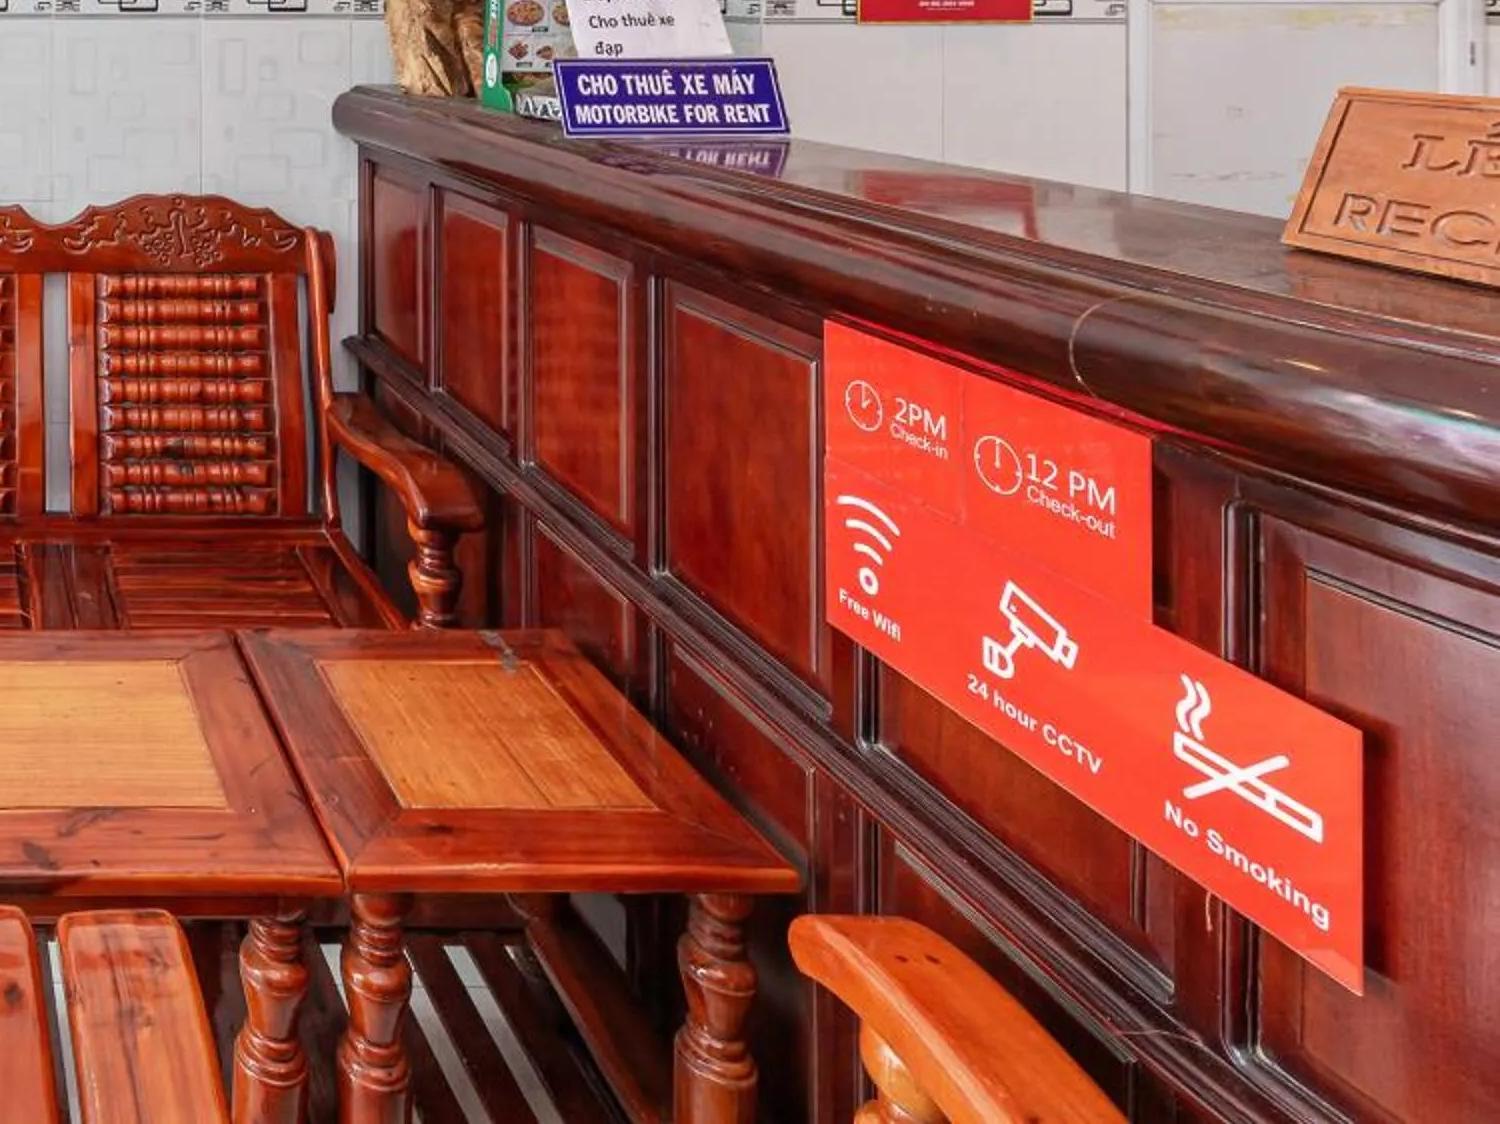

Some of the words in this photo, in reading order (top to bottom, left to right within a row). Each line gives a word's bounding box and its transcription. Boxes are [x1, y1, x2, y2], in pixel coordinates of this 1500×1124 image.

[589, 15, 618, 28] Cho
[621, 12, 655, 27] thuê
[660, 15, 675, 27] xe
[595, 41, 623, 57] đạp
[577, 74, 619, 95] CHO
[621, 69, 676, 95] THUÊ
[680, 74, 709, 95] XE
[713, 68, 755, 95] MÁY
[574, 103, 680, 125] MOTORBIKE
[683, 104, 720, 124] FOR
[723, 104, 771, 124] RENT
[1333, 191, 1500, 255] REC
[894, 397, 947, 441] 2PM
[890, 422, 949, 460] Check-in
[1026, 453, 1059, 491] 12
[1068, 469, 1116, 516] PM
[1026, 484, 1117, 540] Check-out
[838, 587, 869, 621] Free
[967, 672, 989, 700] 24
[993, 689, 1038, 732] hour
[1042, 723, 1103, 774] CCTV
[1164, 799, 1199, 838] No
[1205, 827, 1330, 932] Smoking
